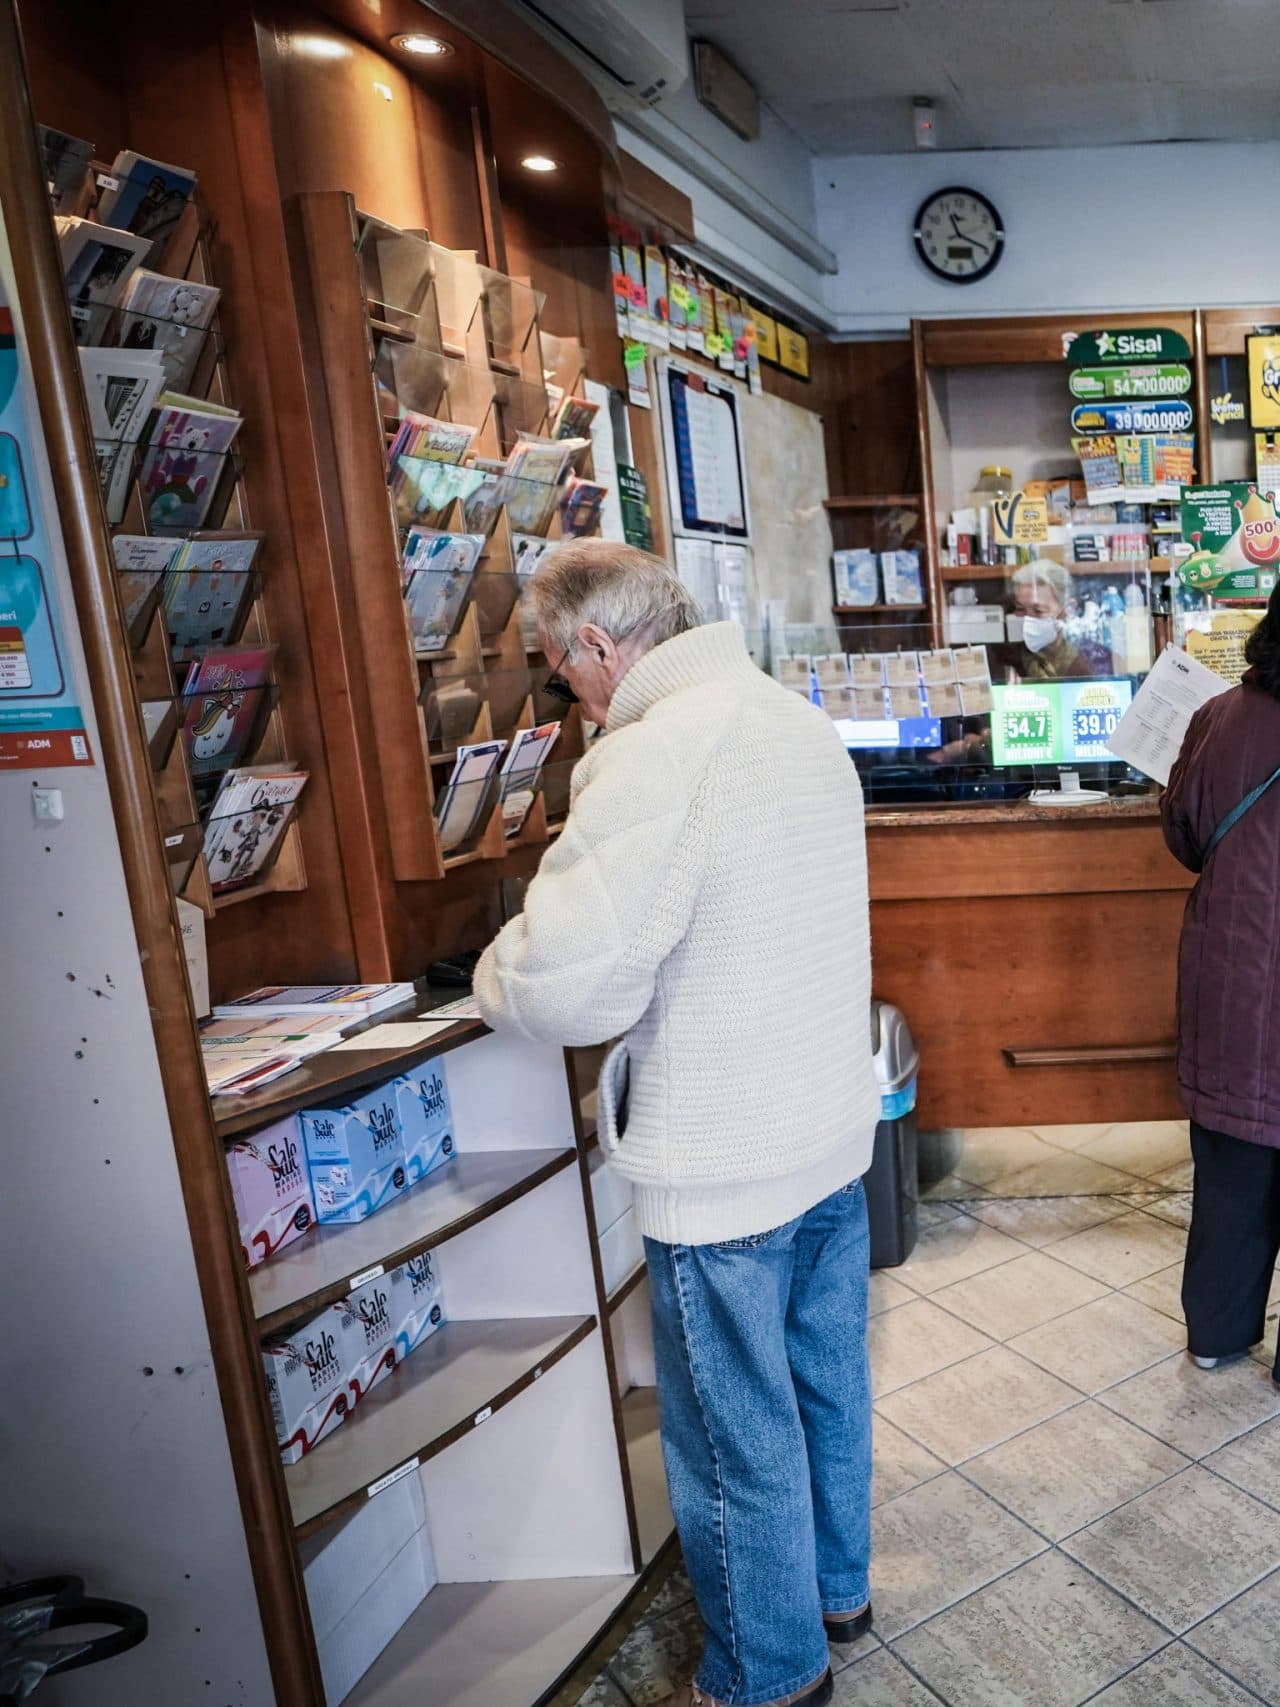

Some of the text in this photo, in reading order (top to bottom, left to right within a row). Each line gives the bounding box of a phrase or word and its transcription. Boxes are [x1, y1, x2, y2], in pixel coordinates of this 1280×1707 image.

[1117, 334, 1163, 354] Sisal
[1007, 716, 1047, 738] 54.7
[1077, 714, 1117, 735] 39.0
[27, 739, 51, 749] ADM
[420, 1073, 445, 1108] Sale
[369, 1102, 395, 1139] Sale
[267, 1137, 298, 1174] Sale
[408, 1251, 433, 1282] Sale
[359, 1288, 388, 1325] Sale
[305, 1331, 337, 1369] Sale
[311, 1360, 340, 1386] MARINO
